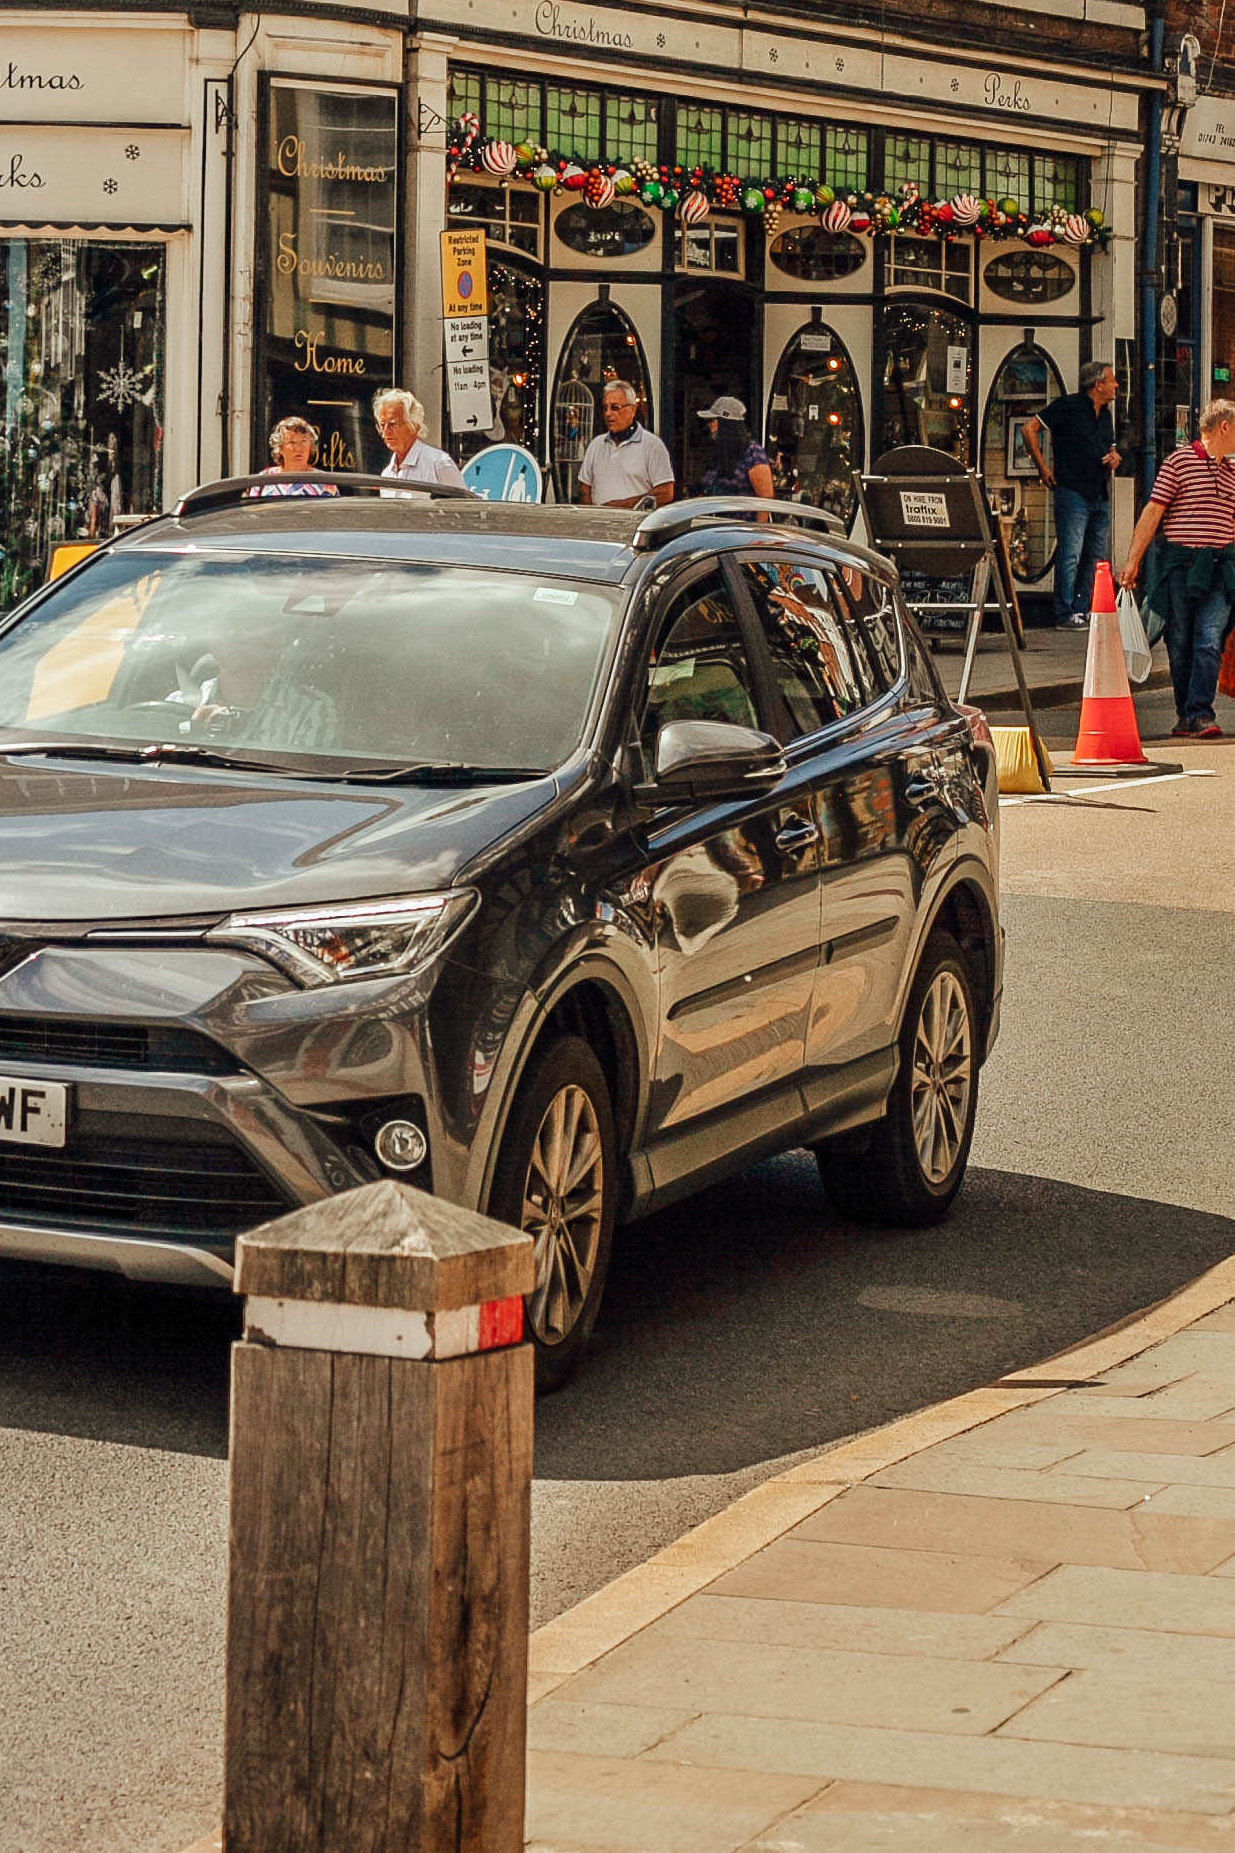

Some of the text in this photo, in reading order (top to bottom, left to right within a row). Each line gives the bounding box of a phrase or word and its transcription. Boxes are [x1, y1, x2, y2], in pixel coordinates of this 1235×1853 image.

[534, 0, 1031, 111] Christmas Perks
[277, 135, 387, 183] Christmas
[448, 234, 479, 245] Restricted
[276, 233, 385, 279] Souvenirs
[452, 246, 475, 256] Parking
[457, 257, 472, 267] Zone
[449, 302, 482, 313] At any time
[450, 320, 482, 331] No loading
[450, 332, 483, 343] at any time
[294, 330, 366, 375] Home
[453, 364, 483, 375] No loading
[454, 382, 469, 391] 11am
[473, 380, 486, 390] 4pm
[904, 494, 943, 504] ON HIRE FROM
[905, 504, 937, 515] traffix
